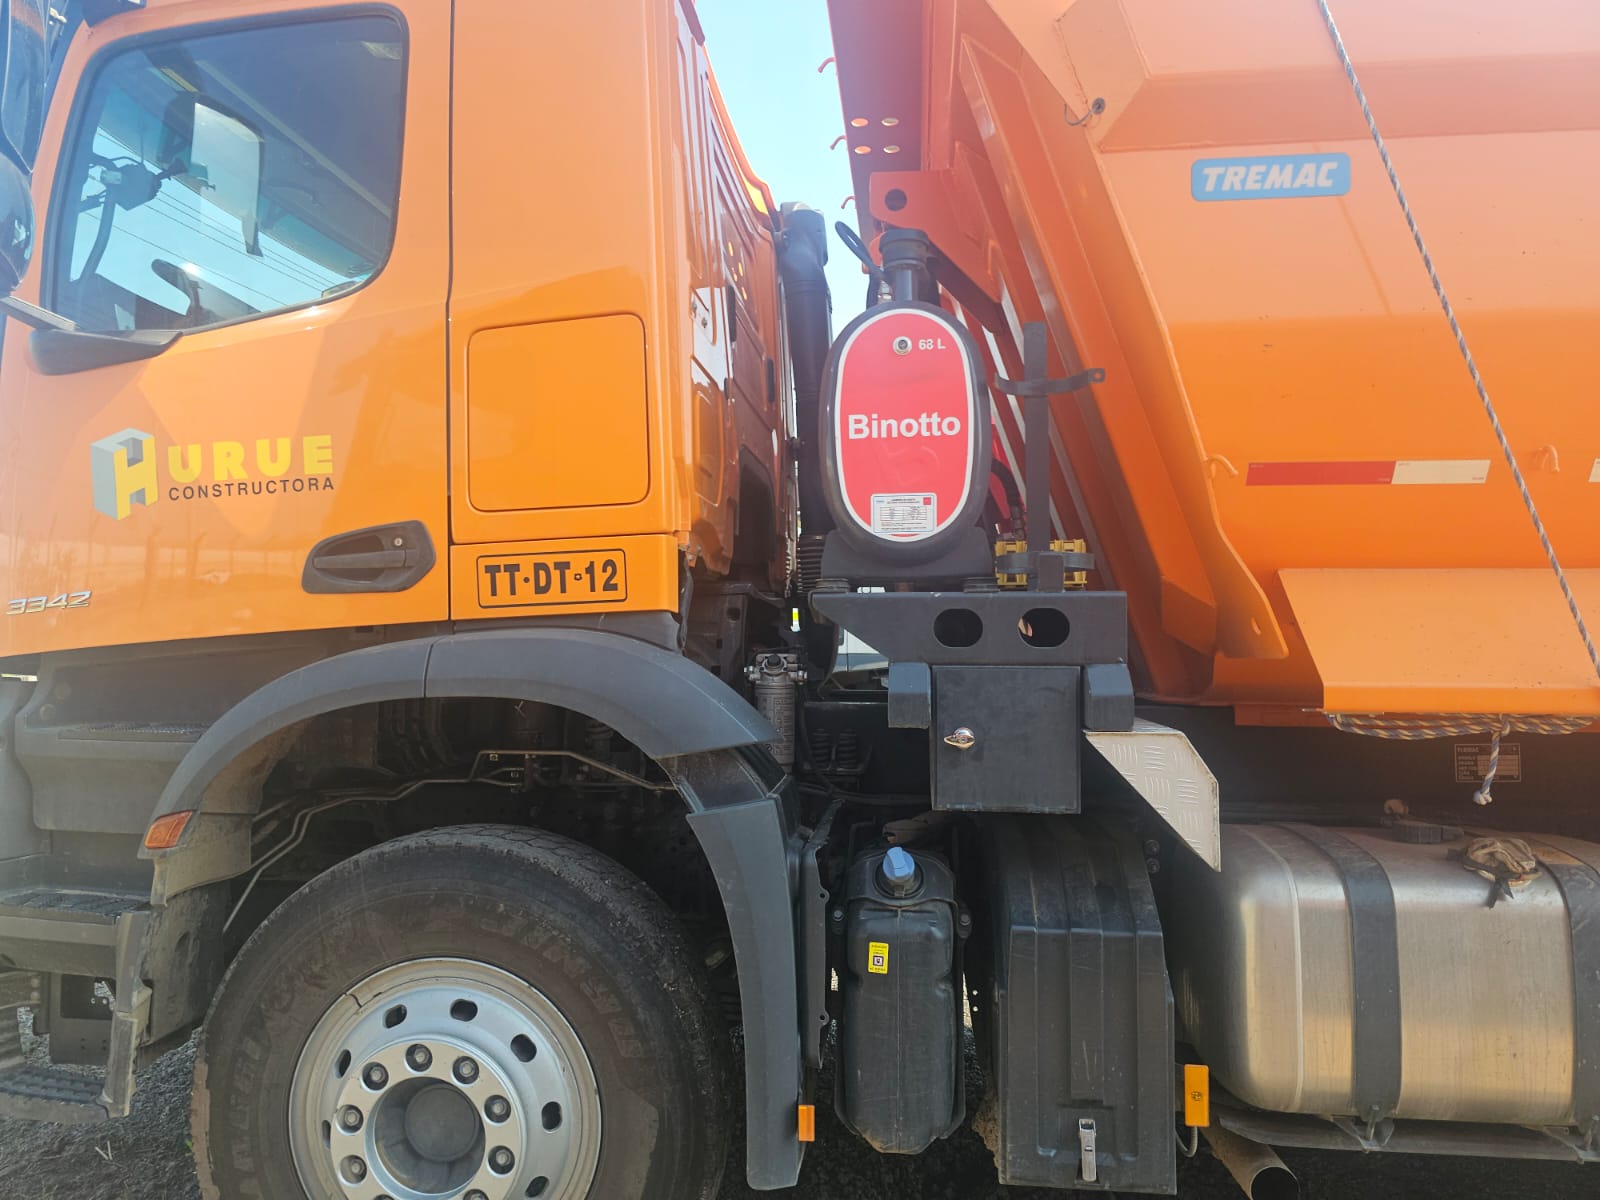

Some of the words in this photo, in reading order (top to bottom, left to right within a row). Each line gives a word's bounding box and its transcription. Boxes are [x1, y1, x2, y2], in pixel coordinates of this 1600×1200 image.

[1202, 161, 1339, 193] TREMAC
[918, 338, 934, 350] 68
[937, 338, 947, 350] L
[847, 411, 961, 440] Binotto
[168, 476, 335, 502] CONSTRUCTORA
[6, 590, 92, 615] 3342
